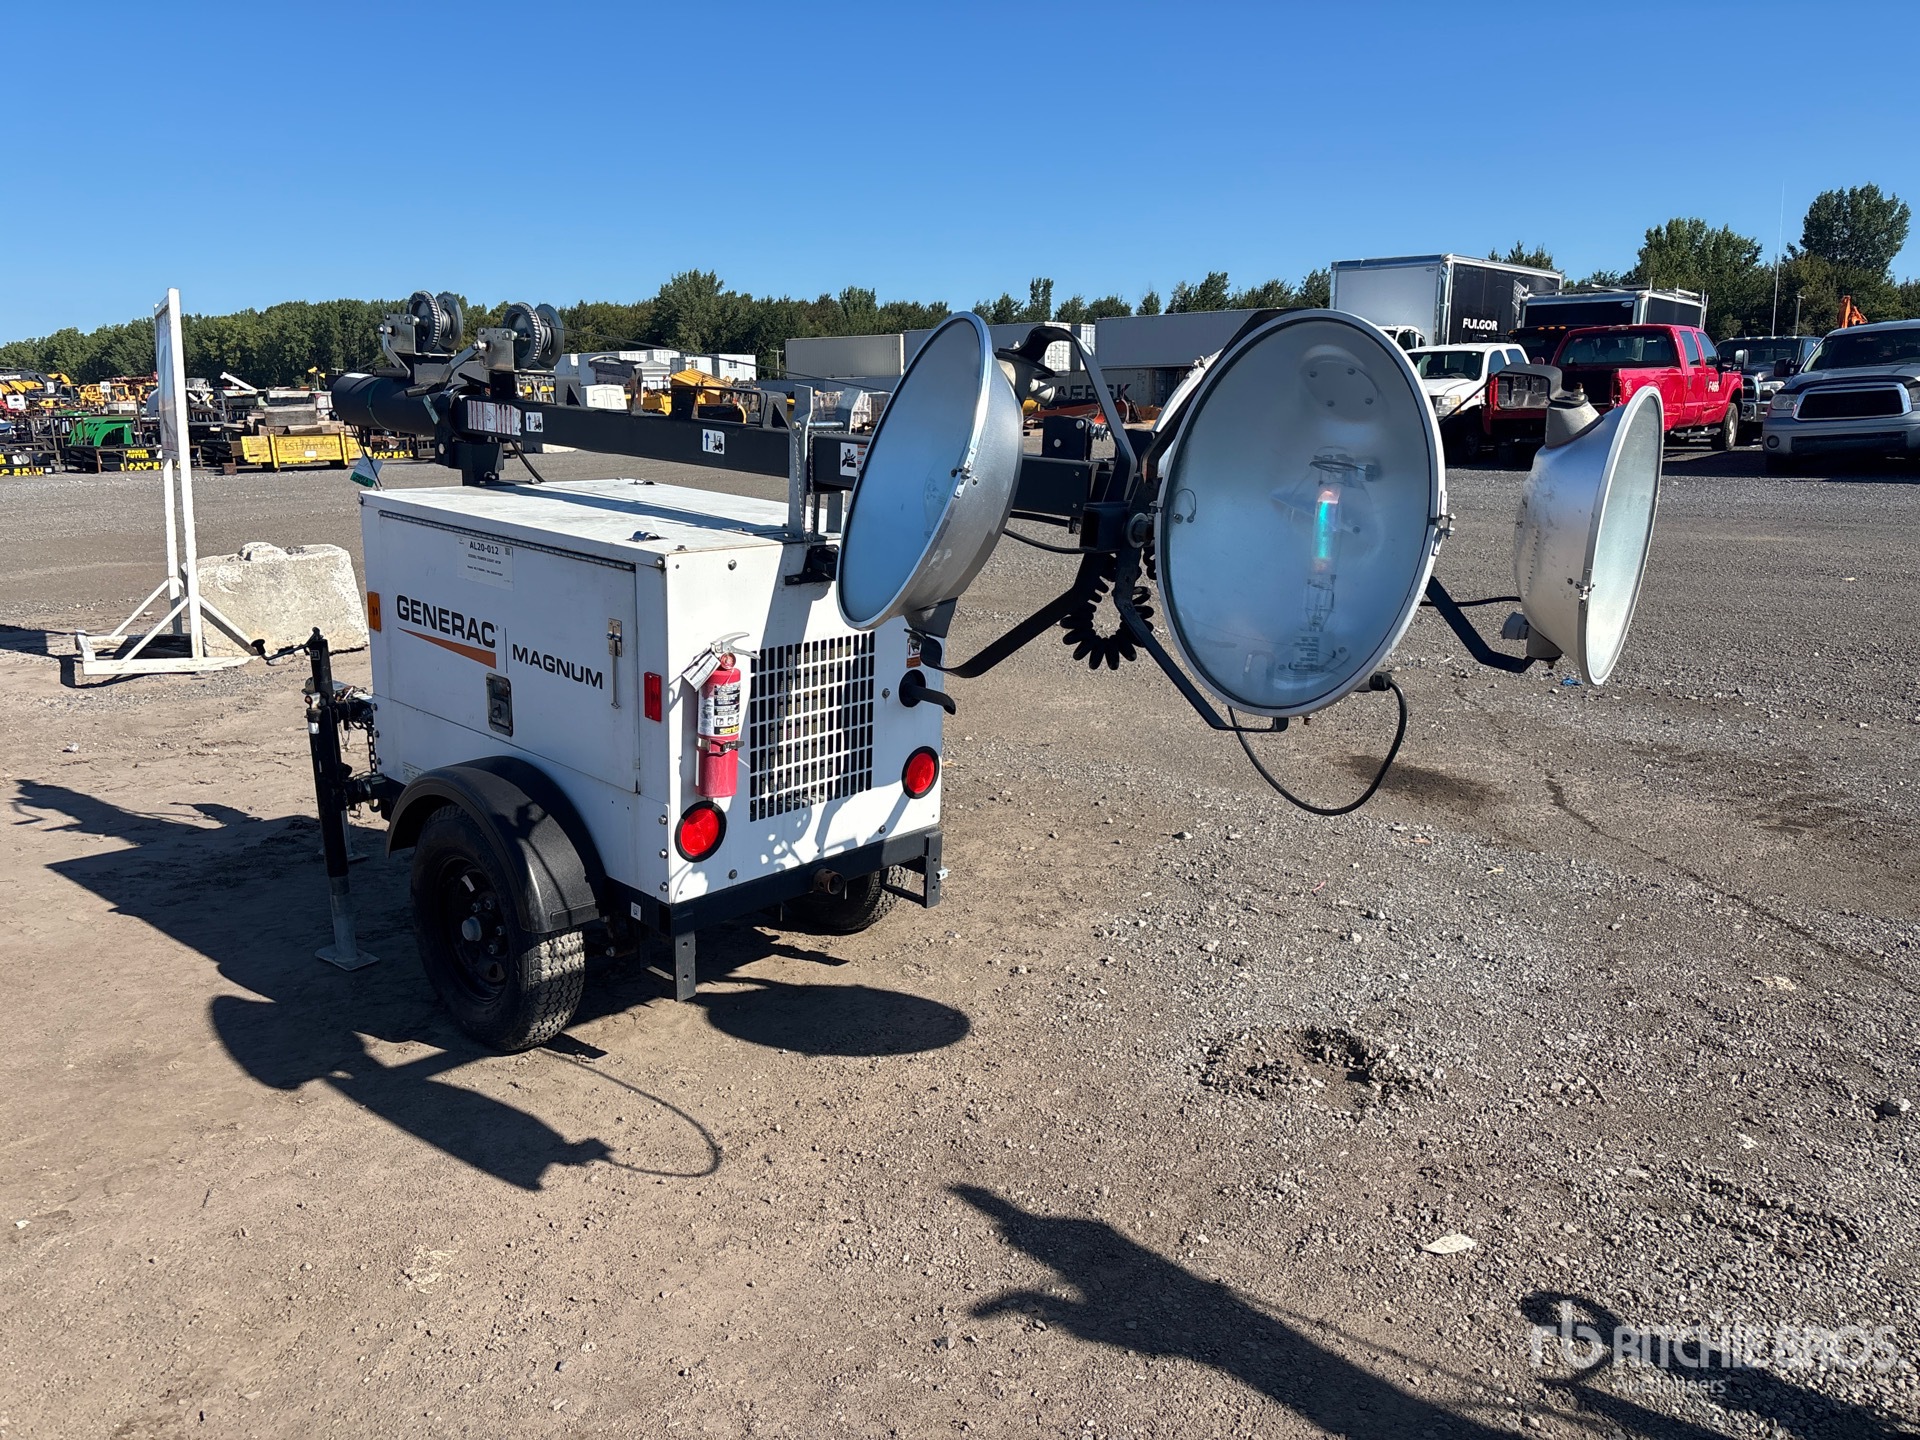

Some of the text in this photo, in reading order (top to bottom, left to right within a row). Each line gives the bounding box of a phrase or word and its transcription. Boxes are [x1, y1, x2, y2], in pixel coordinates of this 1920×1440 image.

[1462, 317, 1498, 331] FULGOR
[470, 541, 499, 555] AL20-012
[397, 595, 496, 648] GENERAC
[512, 643, 603, 689] MAGNUM
